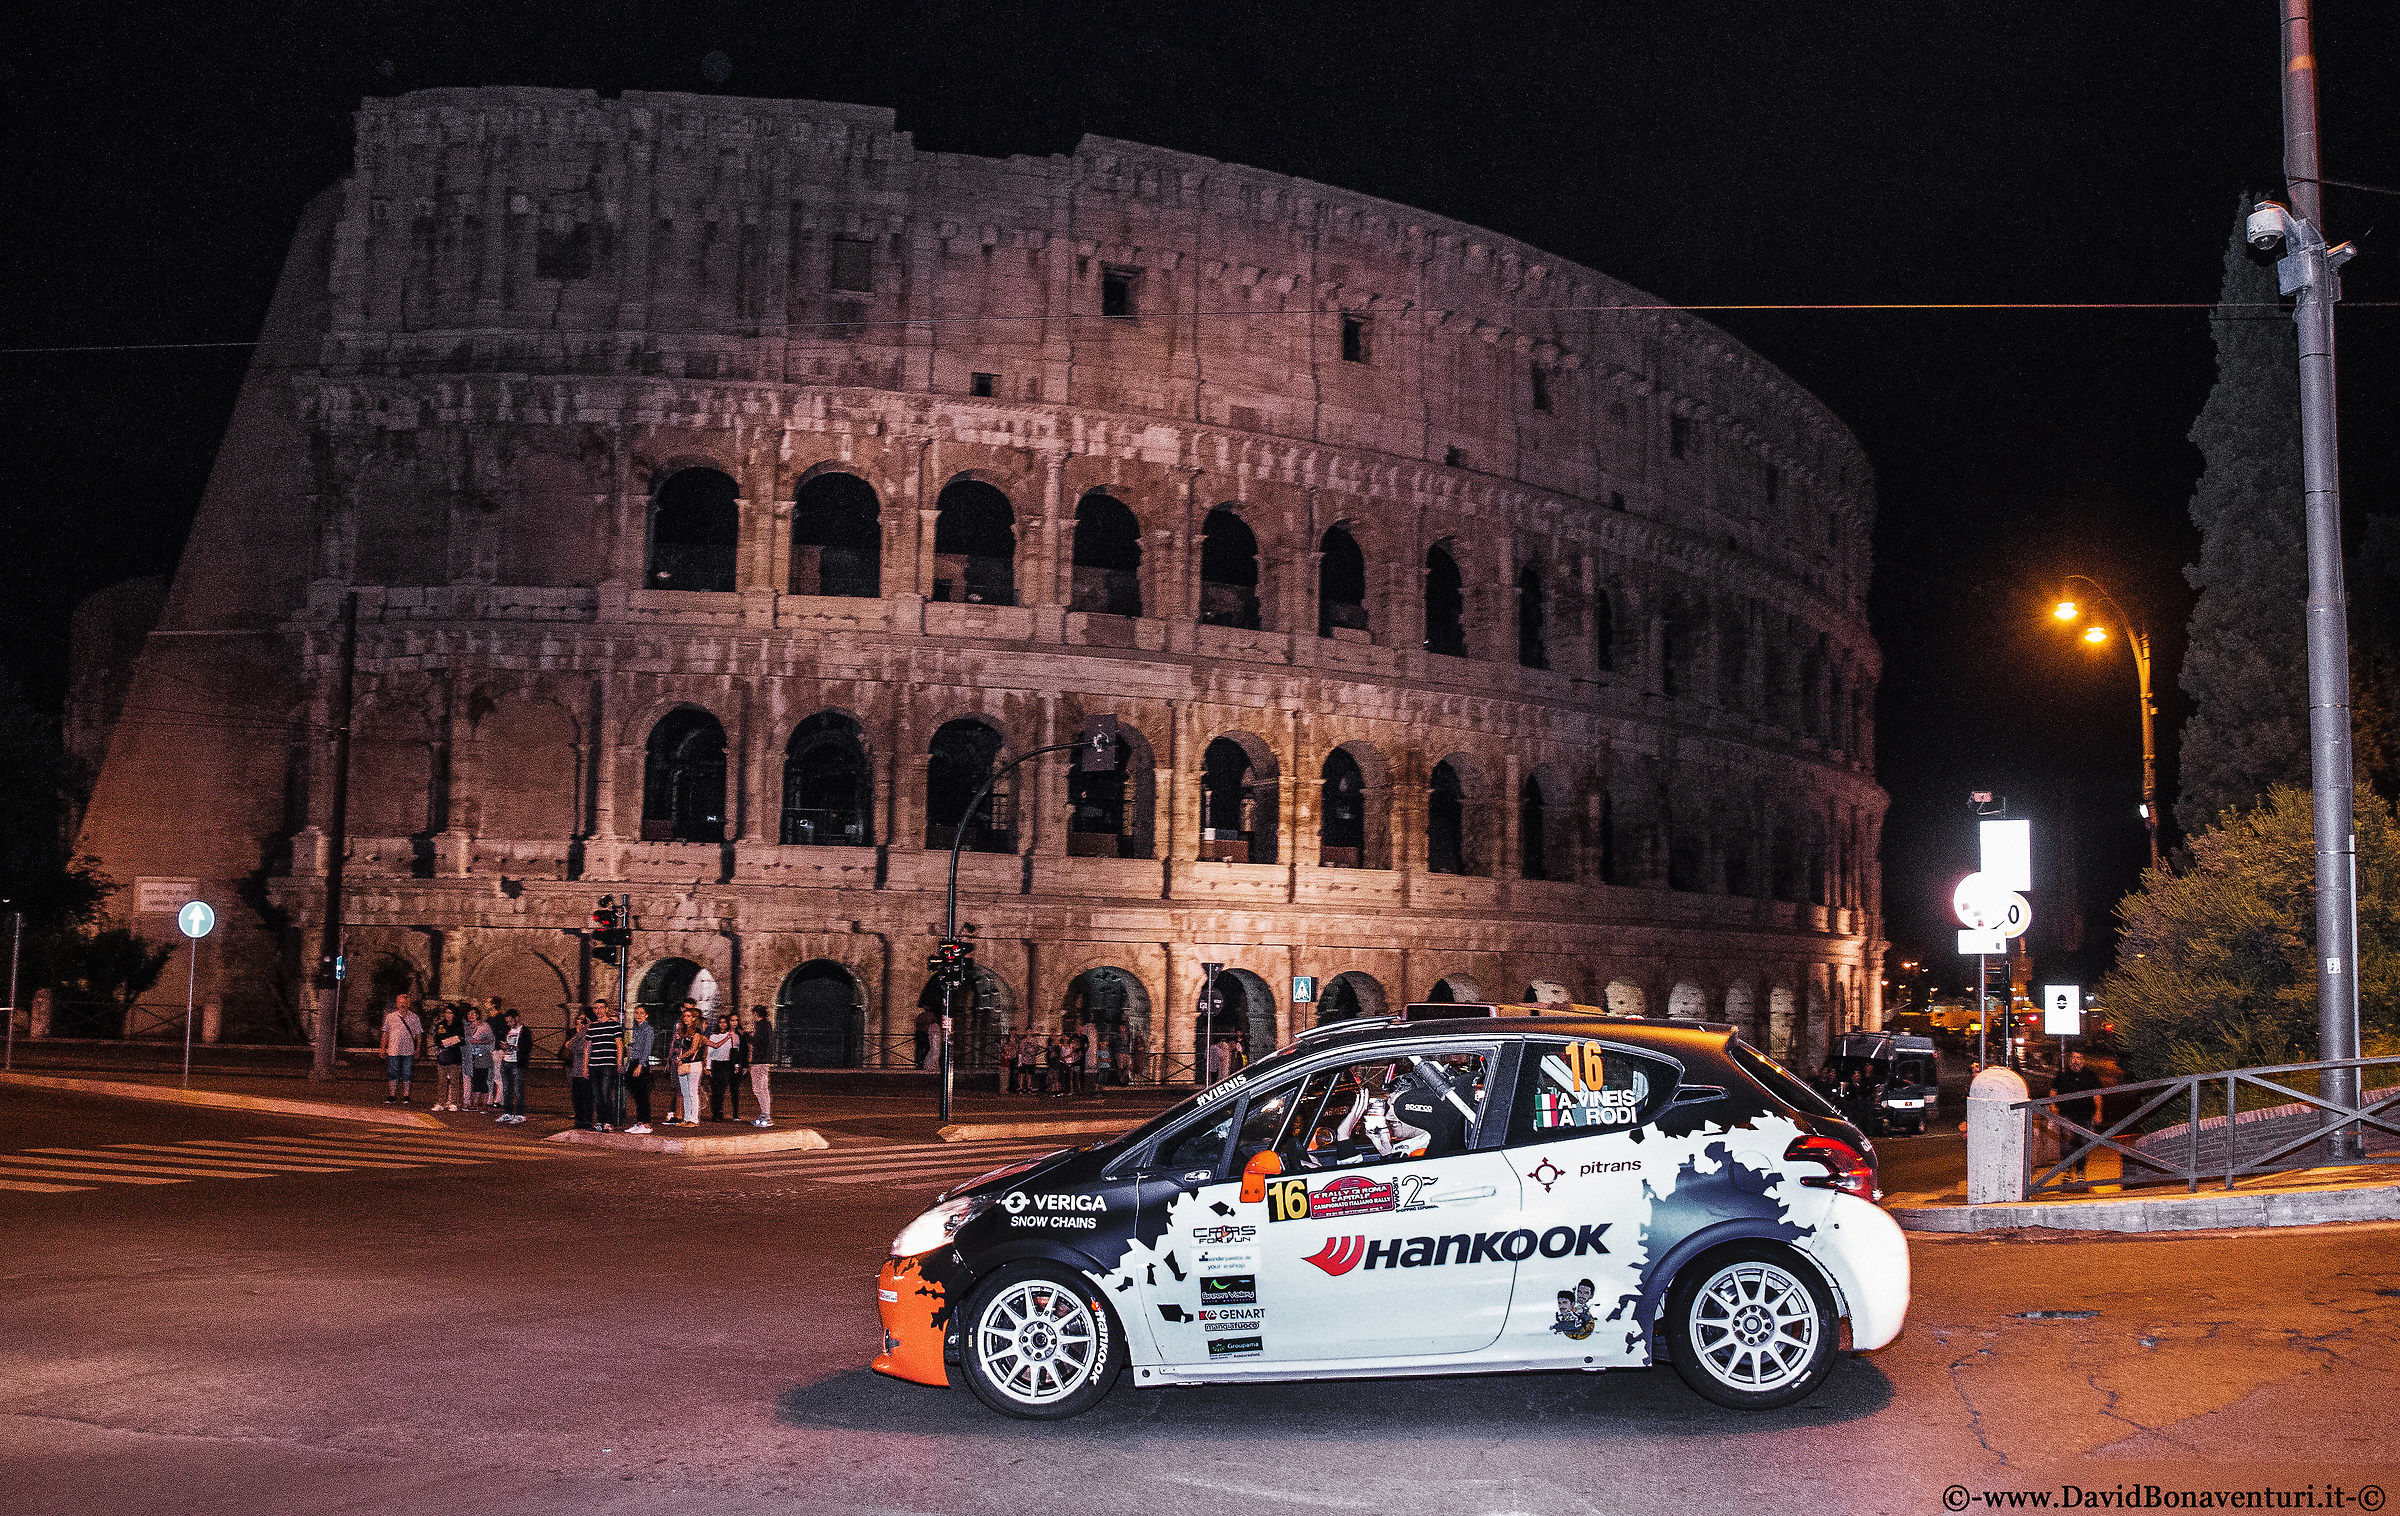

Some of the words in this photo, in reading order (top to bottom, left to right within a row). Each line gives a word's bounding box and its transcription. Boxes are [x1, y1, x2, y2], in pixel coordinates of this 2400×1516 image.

[1565, 1041, 1604, 1092] 16
[1586, 1107, 1637, 1125] RODI
[1580, 1161, 1642, 1177] pitrans
[1033, 1194, 1108, 1212] VERIGA
[1269, 1180, 1308, 1220] 16
[1010, 1215, 1048, 1228] SNOW
[1050, 1216, 1097, 1229] CHAINS
[1219, 1309, 1265, 1319] GENART
